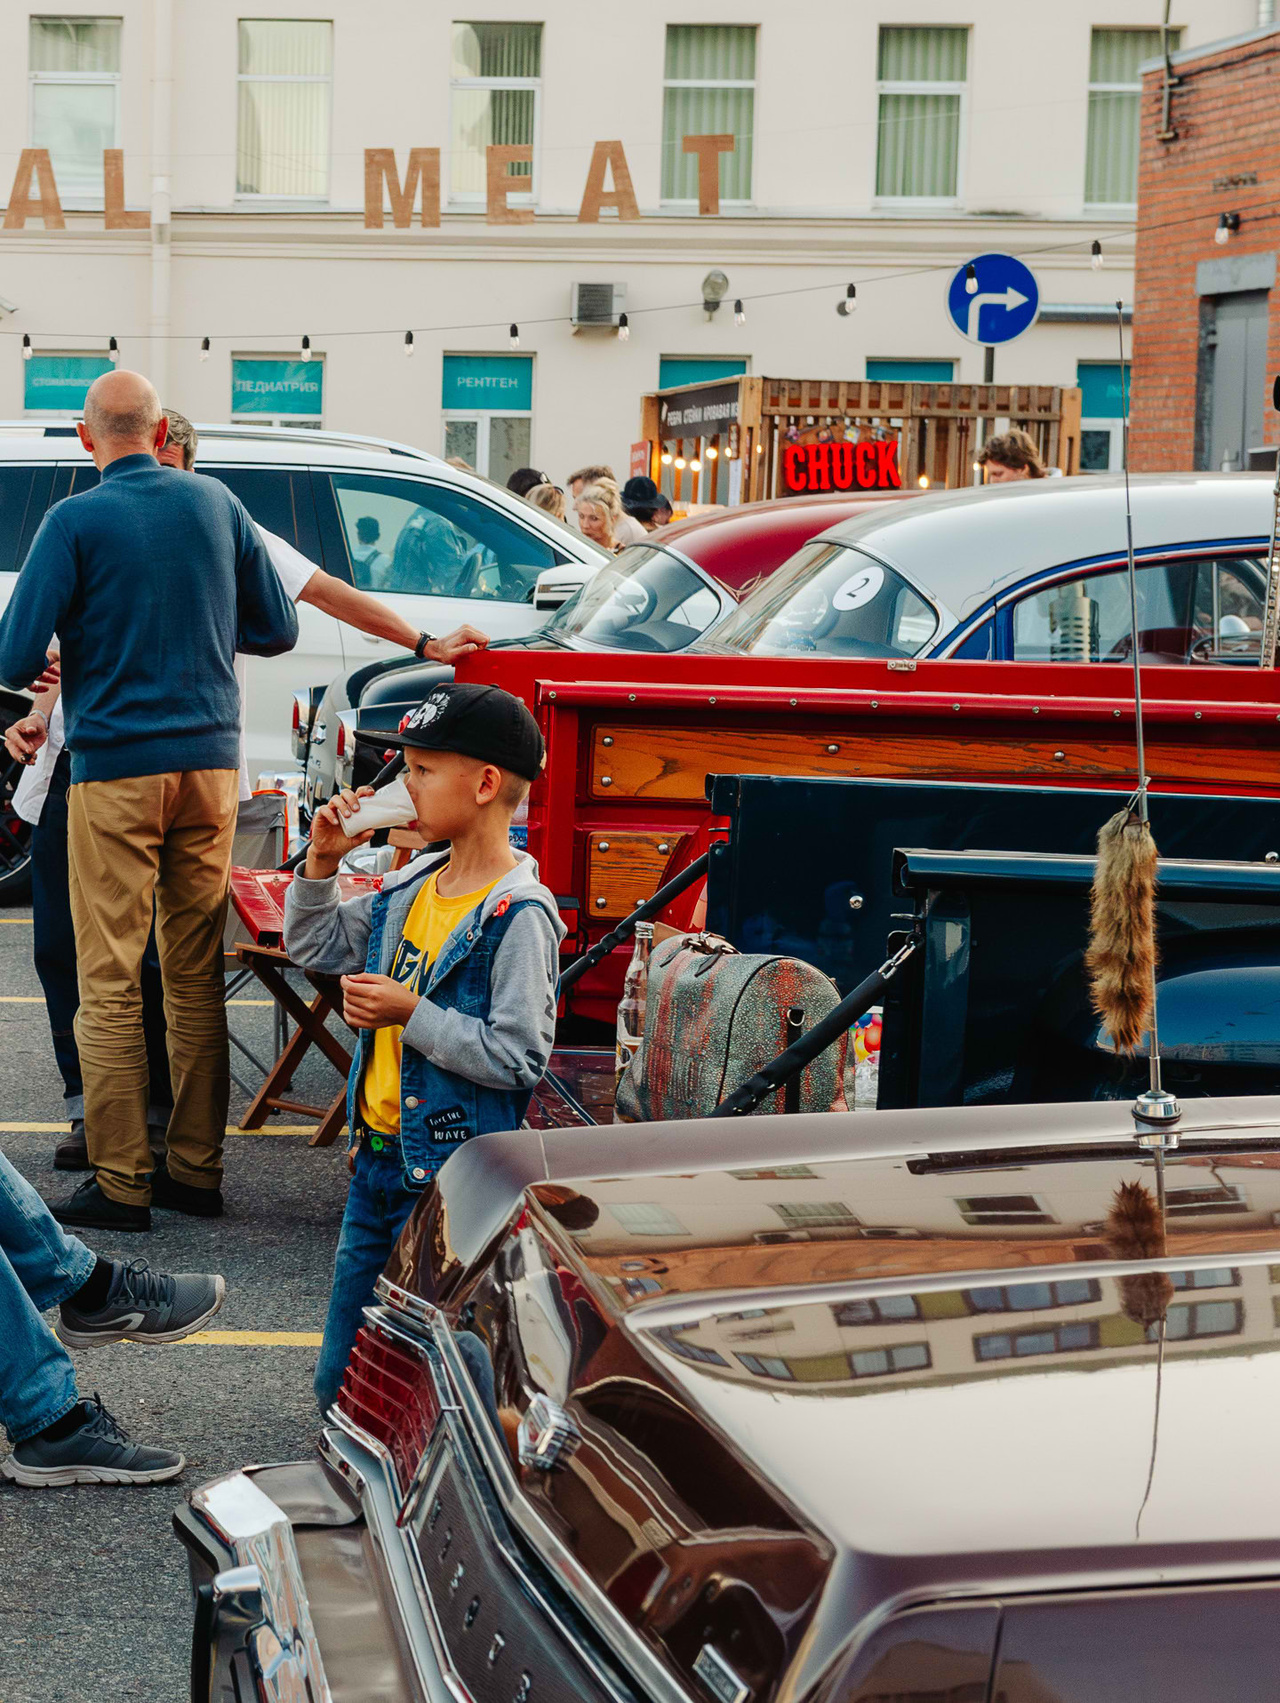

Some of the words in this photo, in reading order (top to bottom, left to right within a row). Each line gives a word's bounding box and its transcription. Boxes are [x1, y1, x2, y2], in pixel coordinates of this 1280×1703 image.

[363, 133, 735, 229] MEAT
[235, 379, 319, 394] ПЕДИАТРИЯ
[457, 376, 519, 389] РЕНТГЕН
[784, 440, 902, 492] CHUCK
[846, 577, 870, 598] 2
[434, 1129, 467, 1141] WAVE
